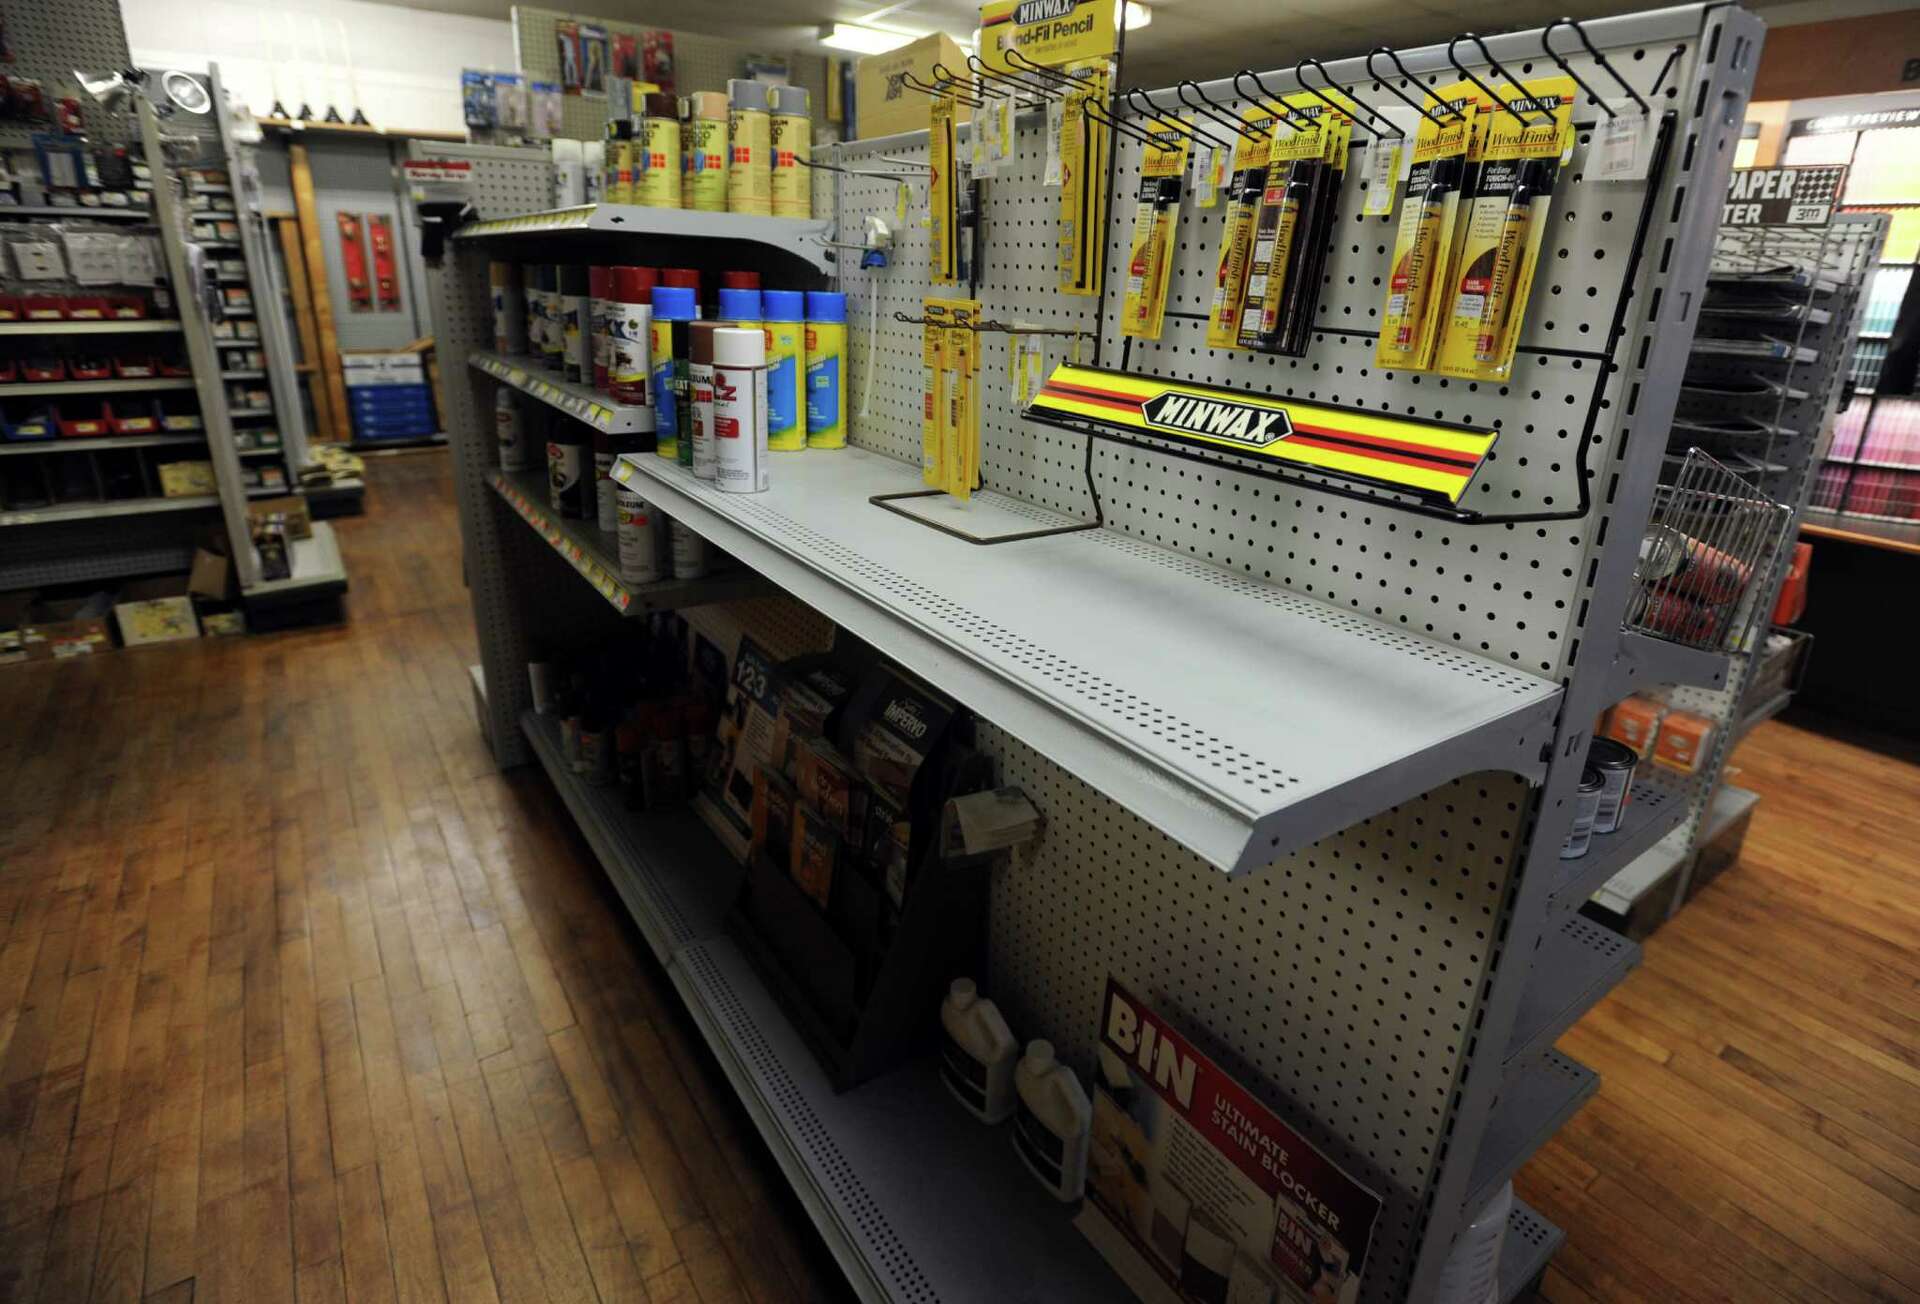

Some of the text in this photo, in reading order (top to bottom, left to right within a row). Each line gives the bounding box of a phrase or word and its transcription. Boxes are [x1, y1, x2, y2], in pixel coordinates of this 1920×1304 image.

[1019, 0, 1073, 25] MINWAX
[1053, 13, 1094, 40] Pencil
[1492, 127, 1561, 146] WoodFinish
[1154, 395, 1281, 443] MINWAX
[883, 700, 927, 738] IMPERVO
[1214, 1091, 1290, 1167] ULTIMATE
[1211, 1109, 1258, 1158] STAIN
[1261, 1156, 1341, 1232] BLOCKER
